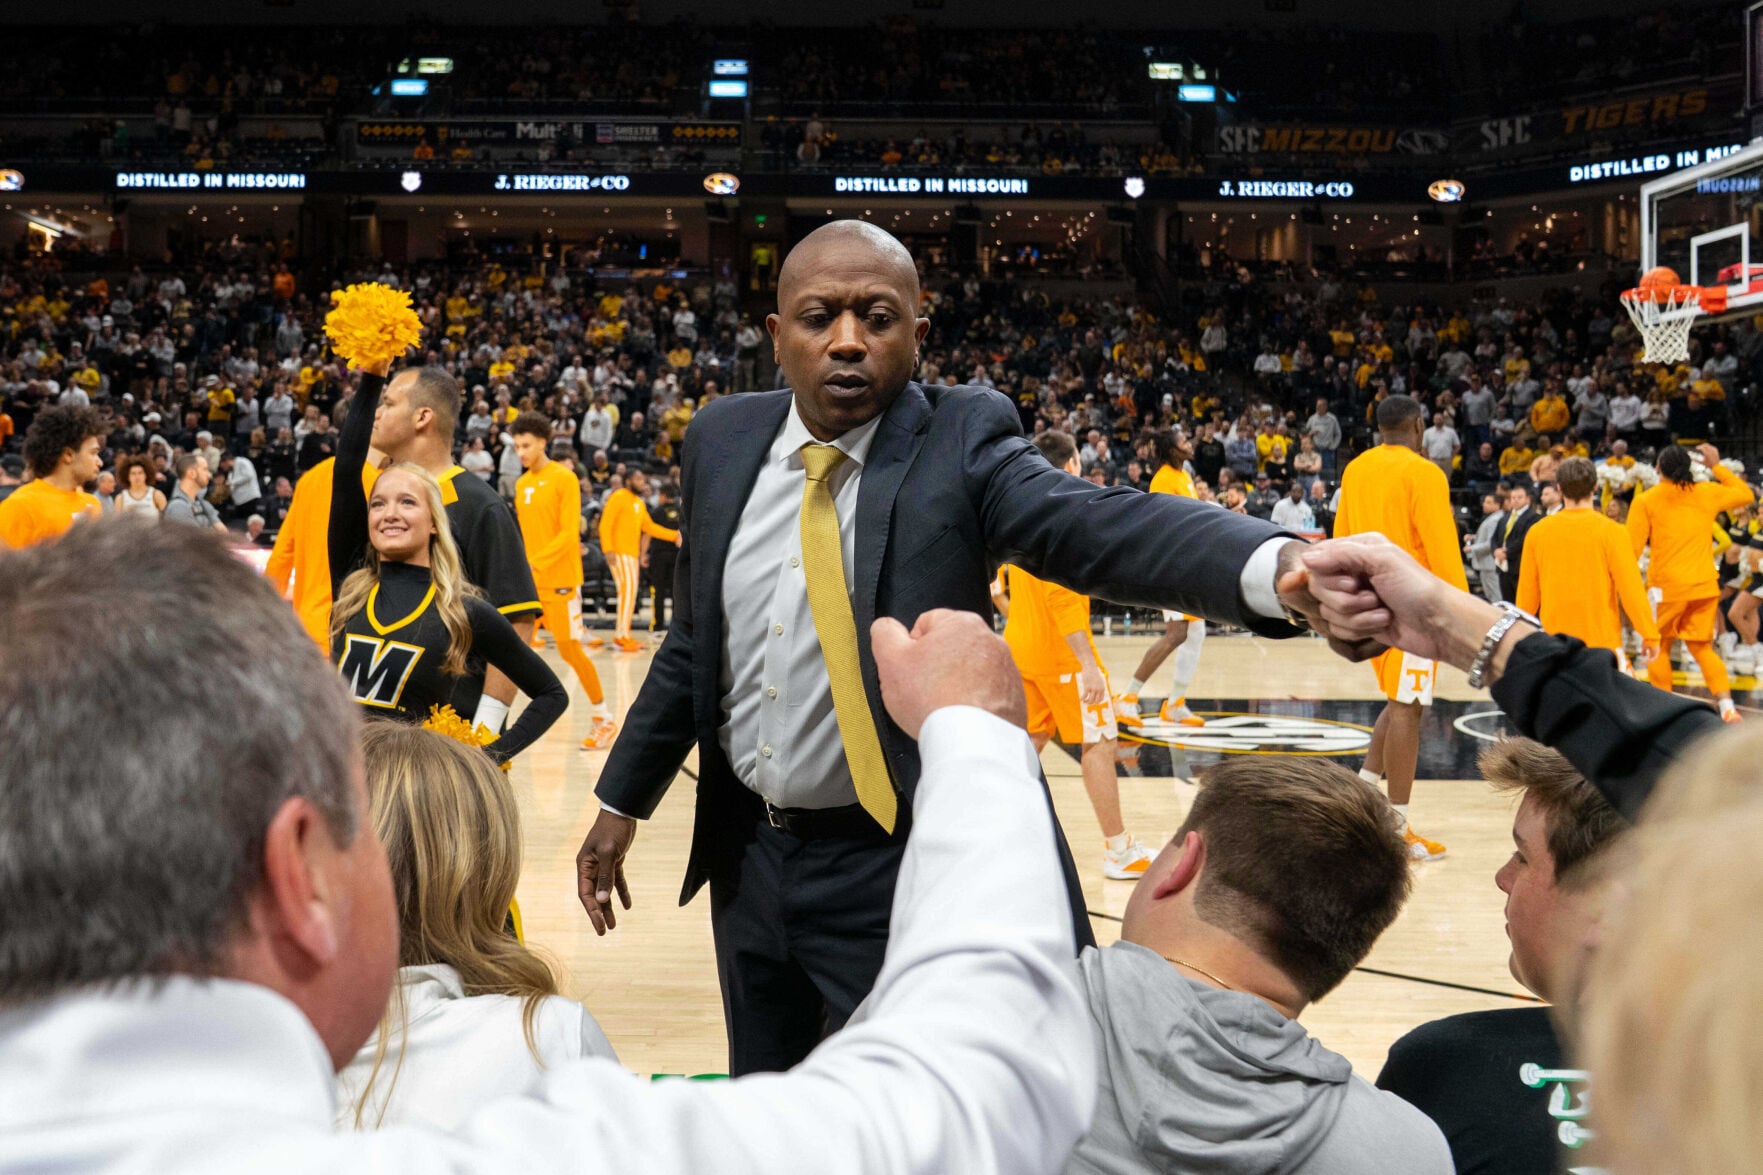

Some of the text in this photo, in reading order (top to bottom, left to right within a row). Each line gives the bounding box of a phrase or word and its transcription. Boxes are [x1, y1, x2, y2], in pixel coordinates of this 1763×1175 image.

[1562, 90, 1709, 134] TIGERS
[1262, 127, 1397, 151] MIZZOU
[1569, 154, 1671, 182] DISTILLED
[1676, 150, 1699, 168] IN
[116, 172, 306, 188] DISTILLED IN MISSOURI
[494, 174, 511, 190] J.
[835, 177, 1029, 194] DISTILLED IN MISSOURI
[1219, 180, 1235, 196] J.
[524, 487, 535, 505] T
[337, 633, 426, 709] M
[1406, 668, 1430, 692] T
[1087, 701, 1109, 727] T
